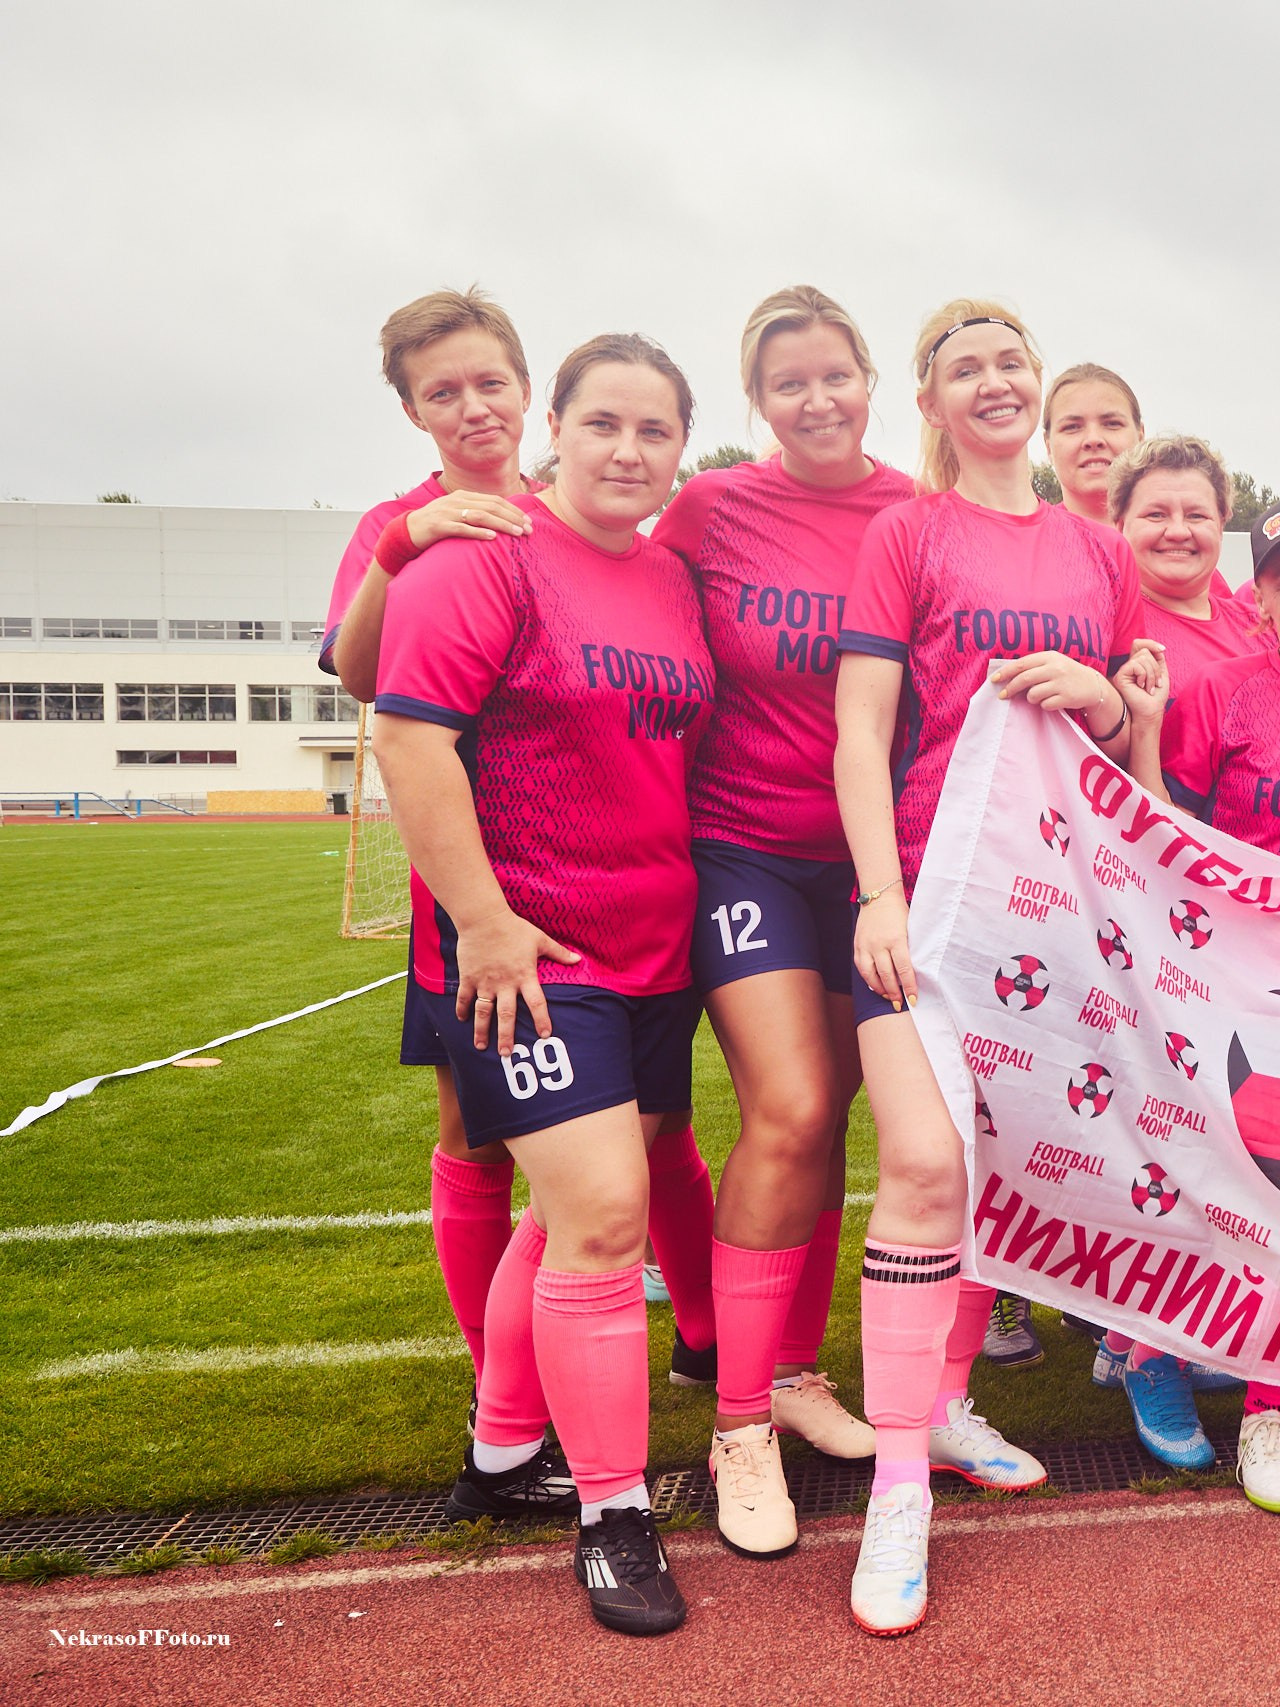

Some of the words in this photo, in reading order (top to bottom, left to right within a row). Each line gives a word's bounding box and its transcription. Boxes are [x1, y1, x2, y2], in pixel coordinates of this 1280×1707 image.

[953, 608, 1106, 662] FOOTBALL
[1092, 862, 1126, 892] MOM!
[1094, 843, 1148, 895] FOOTBALL
[1007, 894, 1050, 923] MOM!
[1012, 875, 1079, 916] FOOTBALL
[710, 900, 769, 956] 12
[1154, 972, 1188, 1003] MOM!
[1160, 955, 1211, 1003] FOOTBALL
[1077, 1004, 1117, 1035] MOM!
[1085, 986, 1139, 1029] FOOTBALL
[500, 1036, 575, 1100] 69
[963, 1032, 1035, 1072] FOOTBALL
[1136, 1113, 1173, 1142] MOM!
[1142, 1094, 1206, 1135] FOOTBALL
[1024, 1158, 1068, 1185] MOM!
[1031, 1141, 1106, 1177] FOOTBALL
[1205, 1203, 1271, 1248] FOOTBALL
[973, 1171, 1264, 1358] НИЖНИЙ
